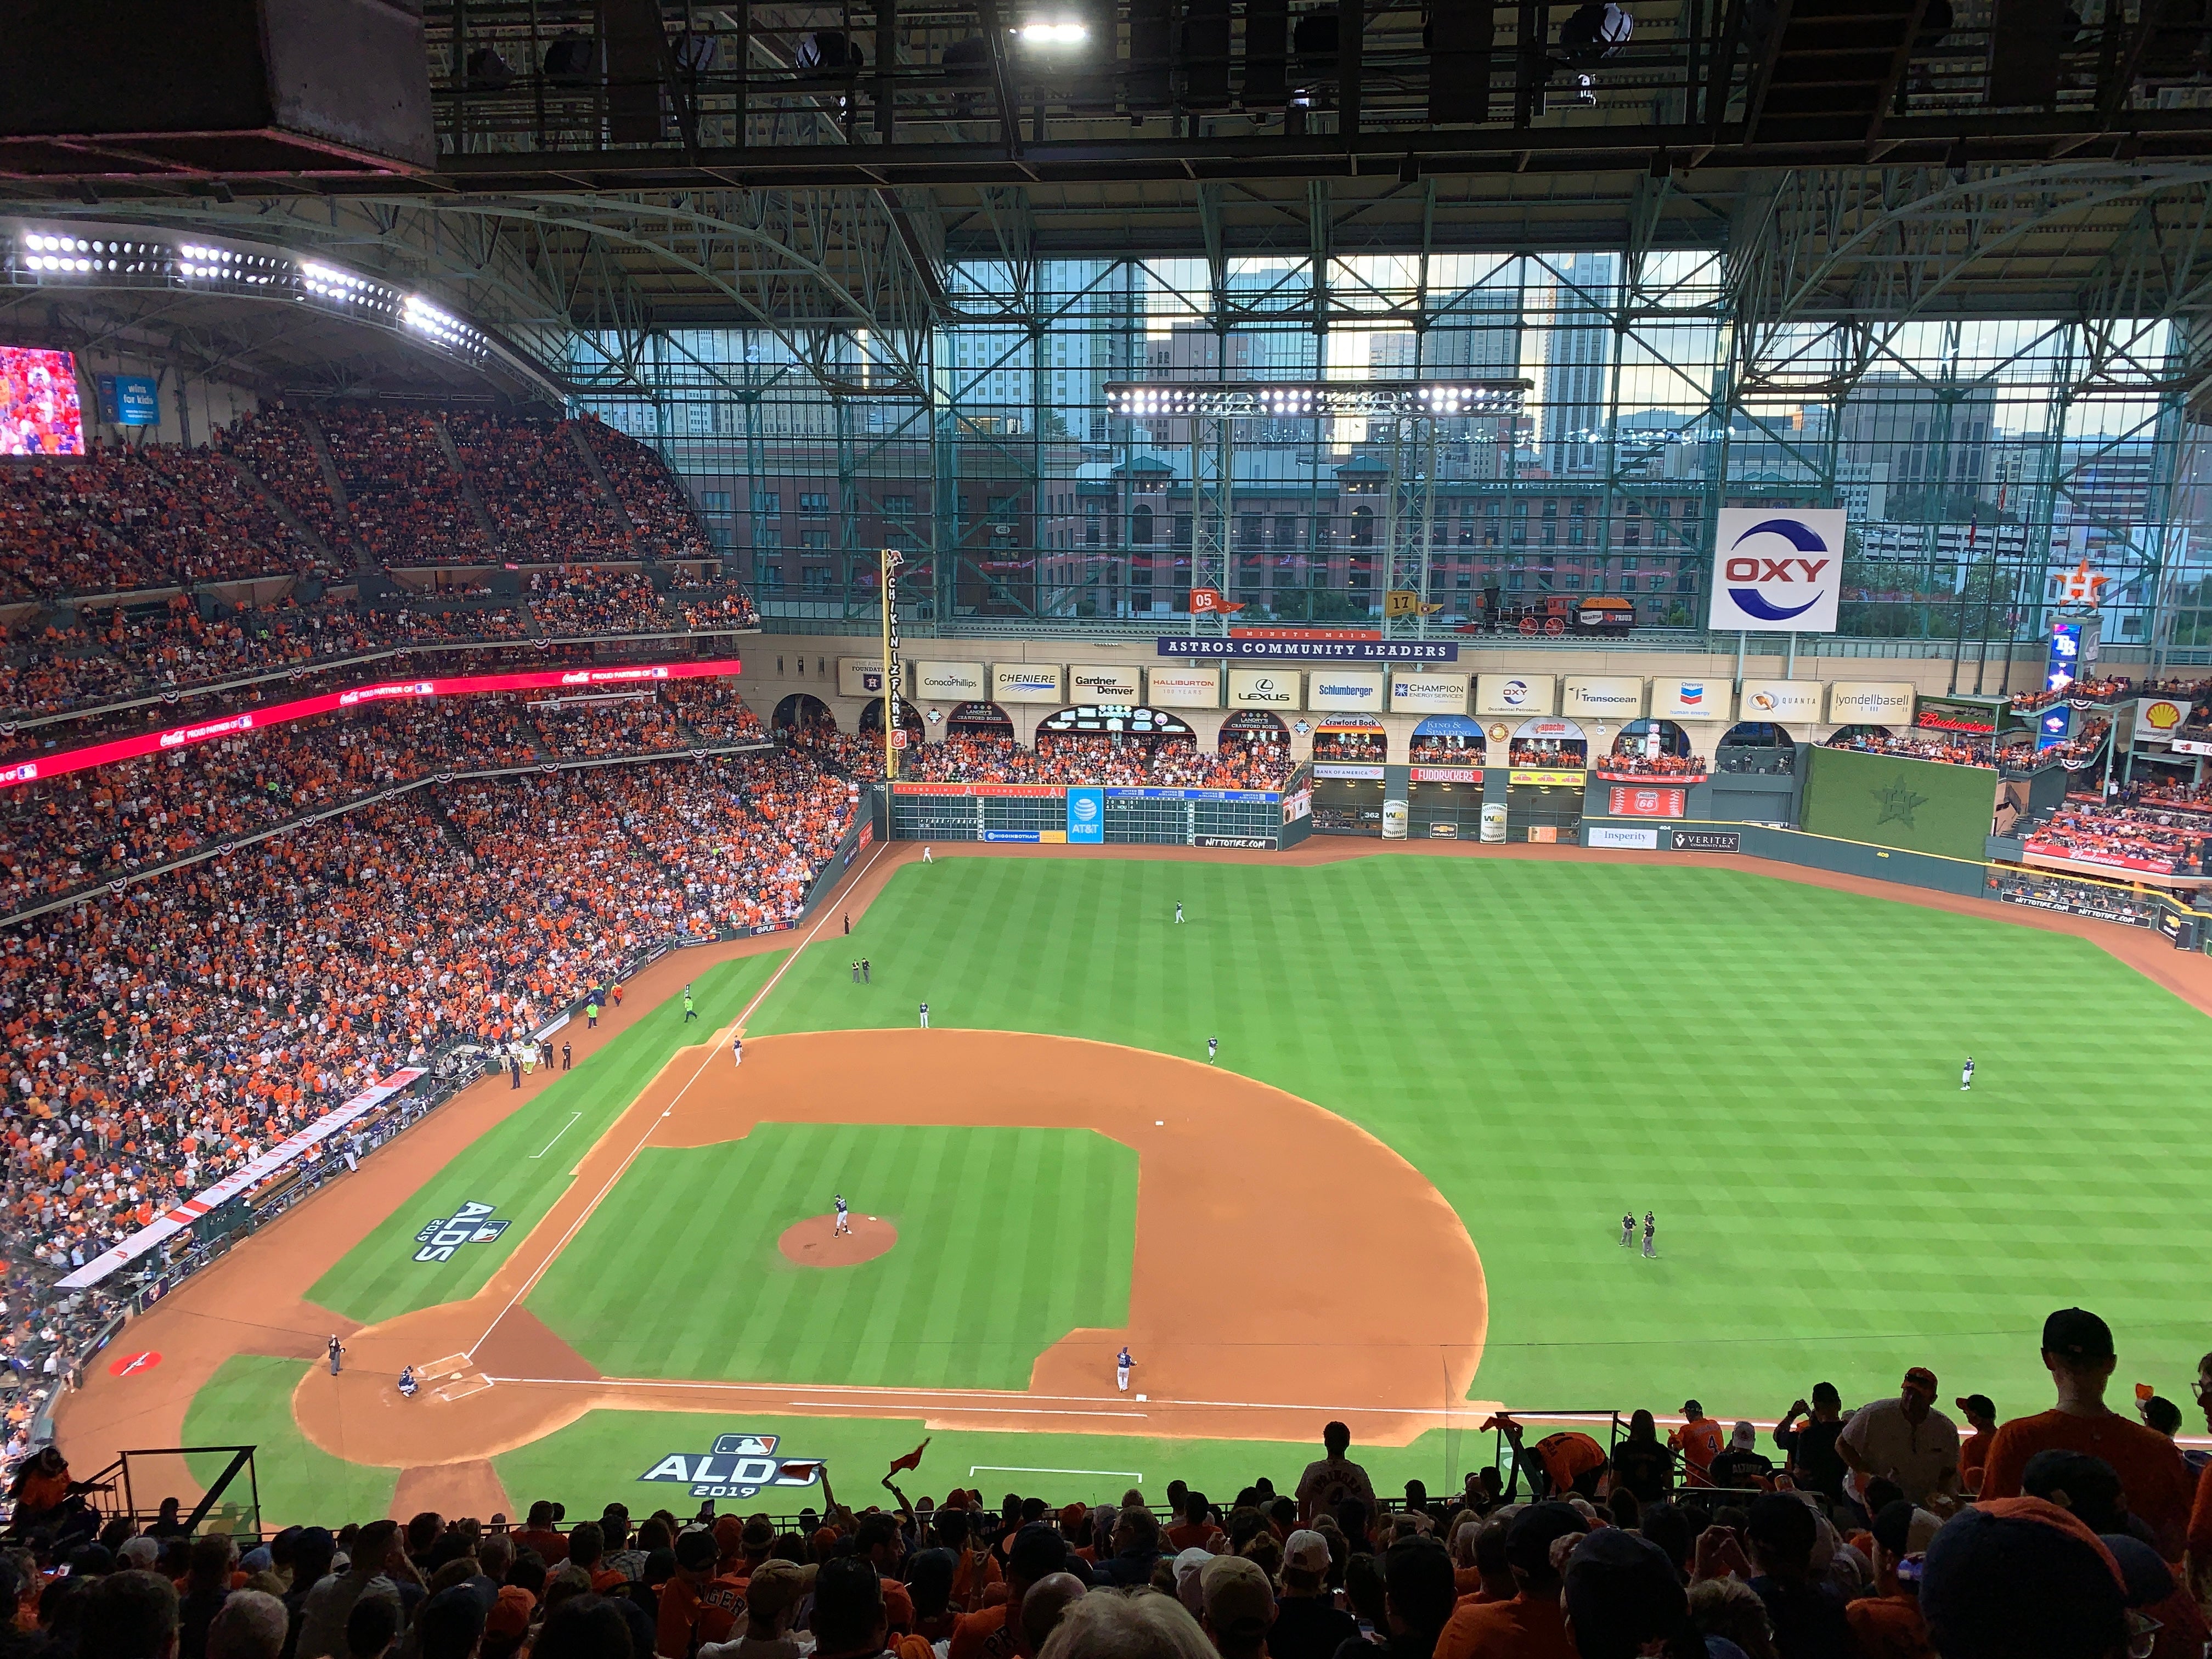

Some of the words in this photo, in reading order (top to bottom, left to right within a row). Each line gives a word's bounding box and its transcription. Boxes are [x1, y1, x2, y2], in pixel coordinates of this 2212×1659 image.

[128, 384, 146, 393] wins
[123, 394, 135, 404] for
[137, 394, 154, 404] kids
[1726, 557, 1830, 583] OXY
[1196, 594, 1212, 607] 05
[1393, 596, 1409, 609] 17
[887, 577, 900, 648] CHIKIN
[1242, 643, 1356, 655] COMMUNITY
[1364, 646, 1446, 657] LEADERS
[2053, 635, 2077, 656] TB
[592, 672, 613, 680] PROUD
[614, 670, 642, 679] PARTNER
[1000, 674, 1056, 684] CHENIERE
[1075, 676, 1116, 686] Gardner
[924, 678, 977, 689] ConocoPhillips
[1409, 684, 1464, 693] CHAMPION
[360, 690, 374, 698] PROUD
[374, 686, 403, 696] PARTNER
[1097, 686, 1134, 695] Denver
[1319, 685, 1373, 697] Schlumberger
[890, 679, 901, 727] FARE
[1238, 693, 1290, 701] LEXUS
[1582, 694, 1637, 703] Transocean
[1782, 697, 1816, 705] QUANTA
[1836, 693, 1909, 706] lyondellbasell
[1541, 723, 1565, 731] apache
[1918, 712, 1995, 732] Budweiser
[187, 727, 206, 739] PROUD
[206, 722, 230, 734] PARTNER
[230, 720, 238, 729] OF
[5, 770, 17, 781] OF
[1418, 769, 1474, 782] FUDDRUCKERS
[1639, 799, 1654, 808] 66
[1071, 824, 1099, 834] AT&T
[1604, 831, 1647, 842] Insperity
[1688, 836, 1735, 845] VERITEX
[1206, 838, 1266, 849] NITTOTIRE.COM
[2068, 849, 2125, 866] Budweiser
[2015, 896, 2069, 912] NITTOTIRE.COM
[2078, 909, 2135, 924] NITTOTIRE.COM
[756, 923, 789, 934] @PLAYBALL
[318, 1093, 375, 1128] MINUTE
[266, 1132, 312, 1158] MAID
[211, 1164, 263, 1192] PARK
[415, 1201, 494, 1261] ALDS
[417, 1220, 445, 1242] 2019
[1707, 1435, 1718, 1453] 4
[644, 1455, 821, 1486] ALDS
[693, 1486, 755, 1497] 2019
[696, 1582, 746, 1616] NGER
